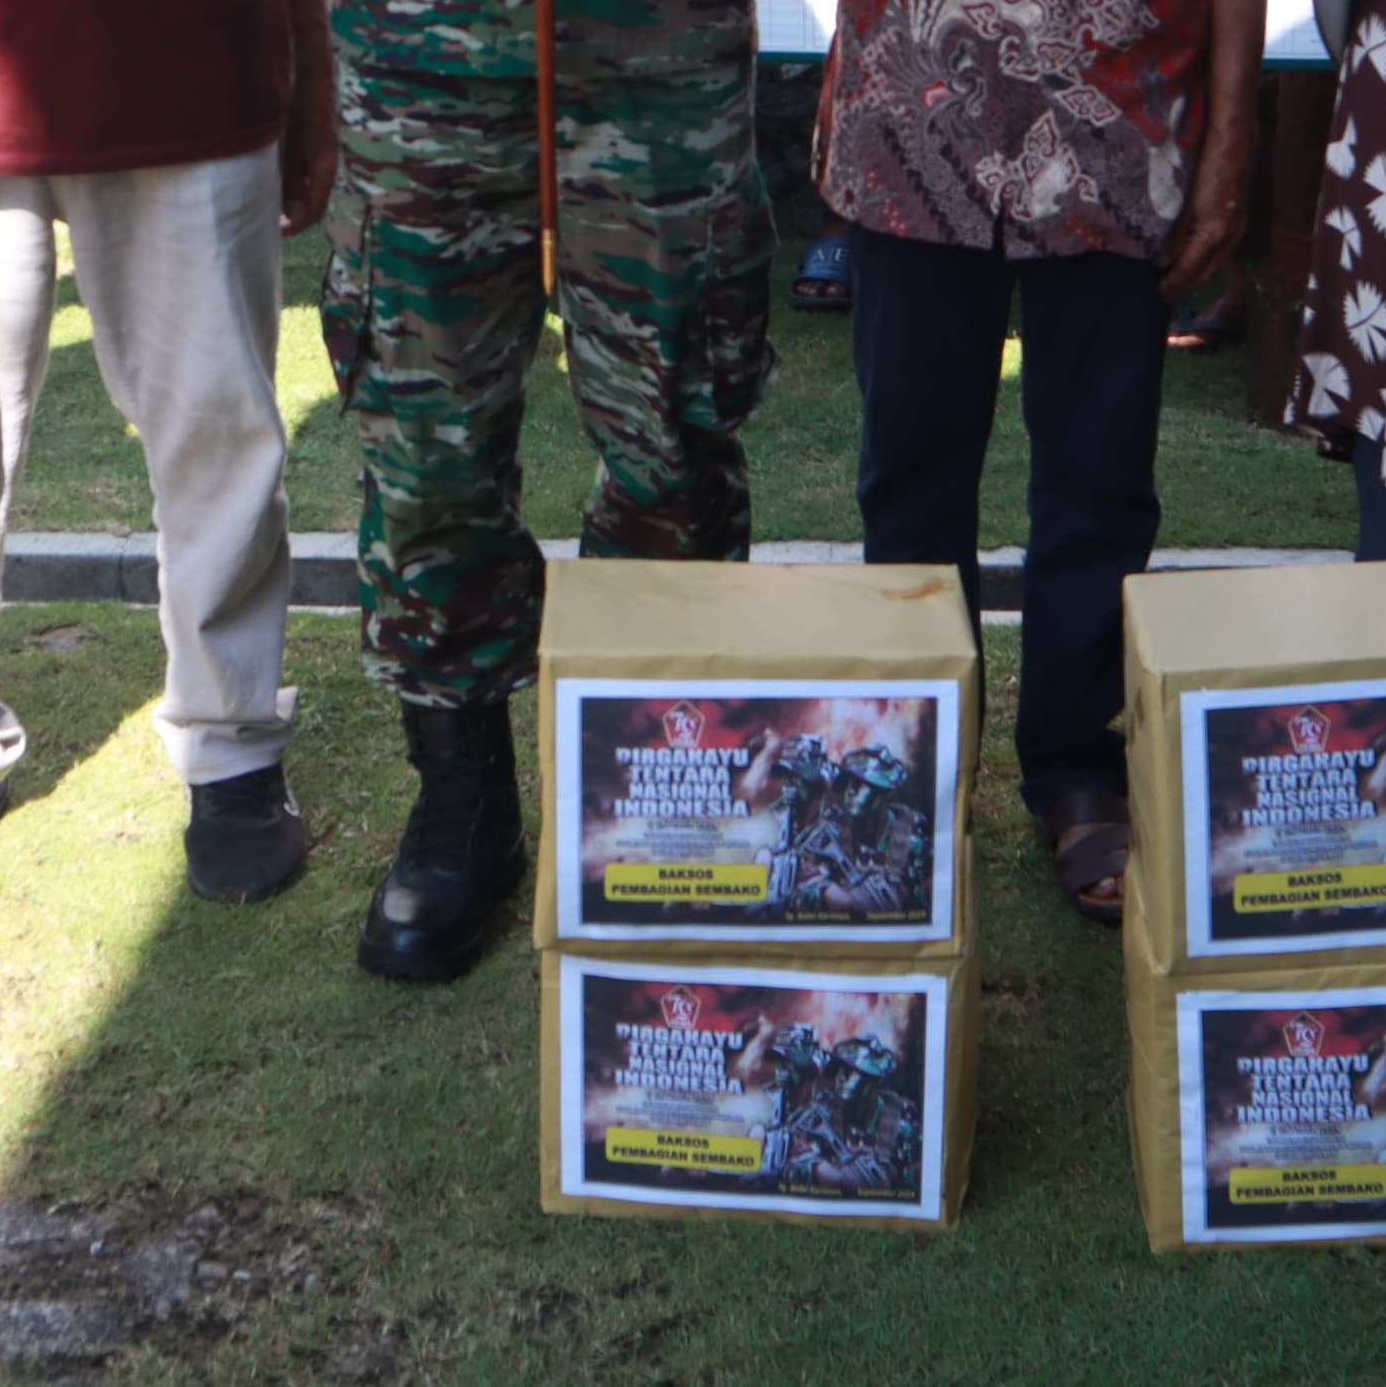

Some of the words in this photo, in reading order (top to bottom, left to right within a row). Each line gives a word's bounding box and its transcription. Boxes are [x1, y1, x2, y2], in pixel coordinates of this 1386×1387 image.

[616, 748, 750, 767] DIRGAHAYU
[1242, 749, 1375, 774] DIRGAHAYU
[630, 766, 730, 783] TENTARA
[1256, 769, 1357, 790] TENTARA
[630, 783, 731, 800] NASIONAL
[1256, 787, 1359, 808] NASIONAL
[615, 799, 750, 817] INDONESIA
[1242, 801, 1377, 828] INDONESIA
[659, 869, 714, 880] BAKSOS
[1287, 872, 1343, 886] BAKSOS
[612, 883, 691, 895] PEMBAGIAN
[696, 883, 761, 895] SEMBAKO
[1241, 890, 1321, 907] PEMBAGIAN
[616, 1023, 744, 1050] DIRGAHAYU
[630, 1042, 725, 1064] TENTARA
[629, 1059, 727, 1077] NASIONAL
[1237, 1054, 1370, 1076] DIRGAHAYU
[615, 1071, 745, 1095] INDONESIA
[1252, 1074, 1352, 1090] TENTARA
[1252, 1091, 1353, 1108] NASIONAL
[1237, 1104, 1372, 1123] INDONESIA
[657, 1134, 710, 1149] BAKSOS
[612, 1146, 688, 1162] PEMBAGIAN
[692, 1151, 755, 1167] SEMBAKO
[1282, 1170, 1337, 1183] BAKSOS
[1236, 1185, 1315, 1197] PEMBAGIAN
[1318, 1182, 1384, 1195] SEMBAKO
